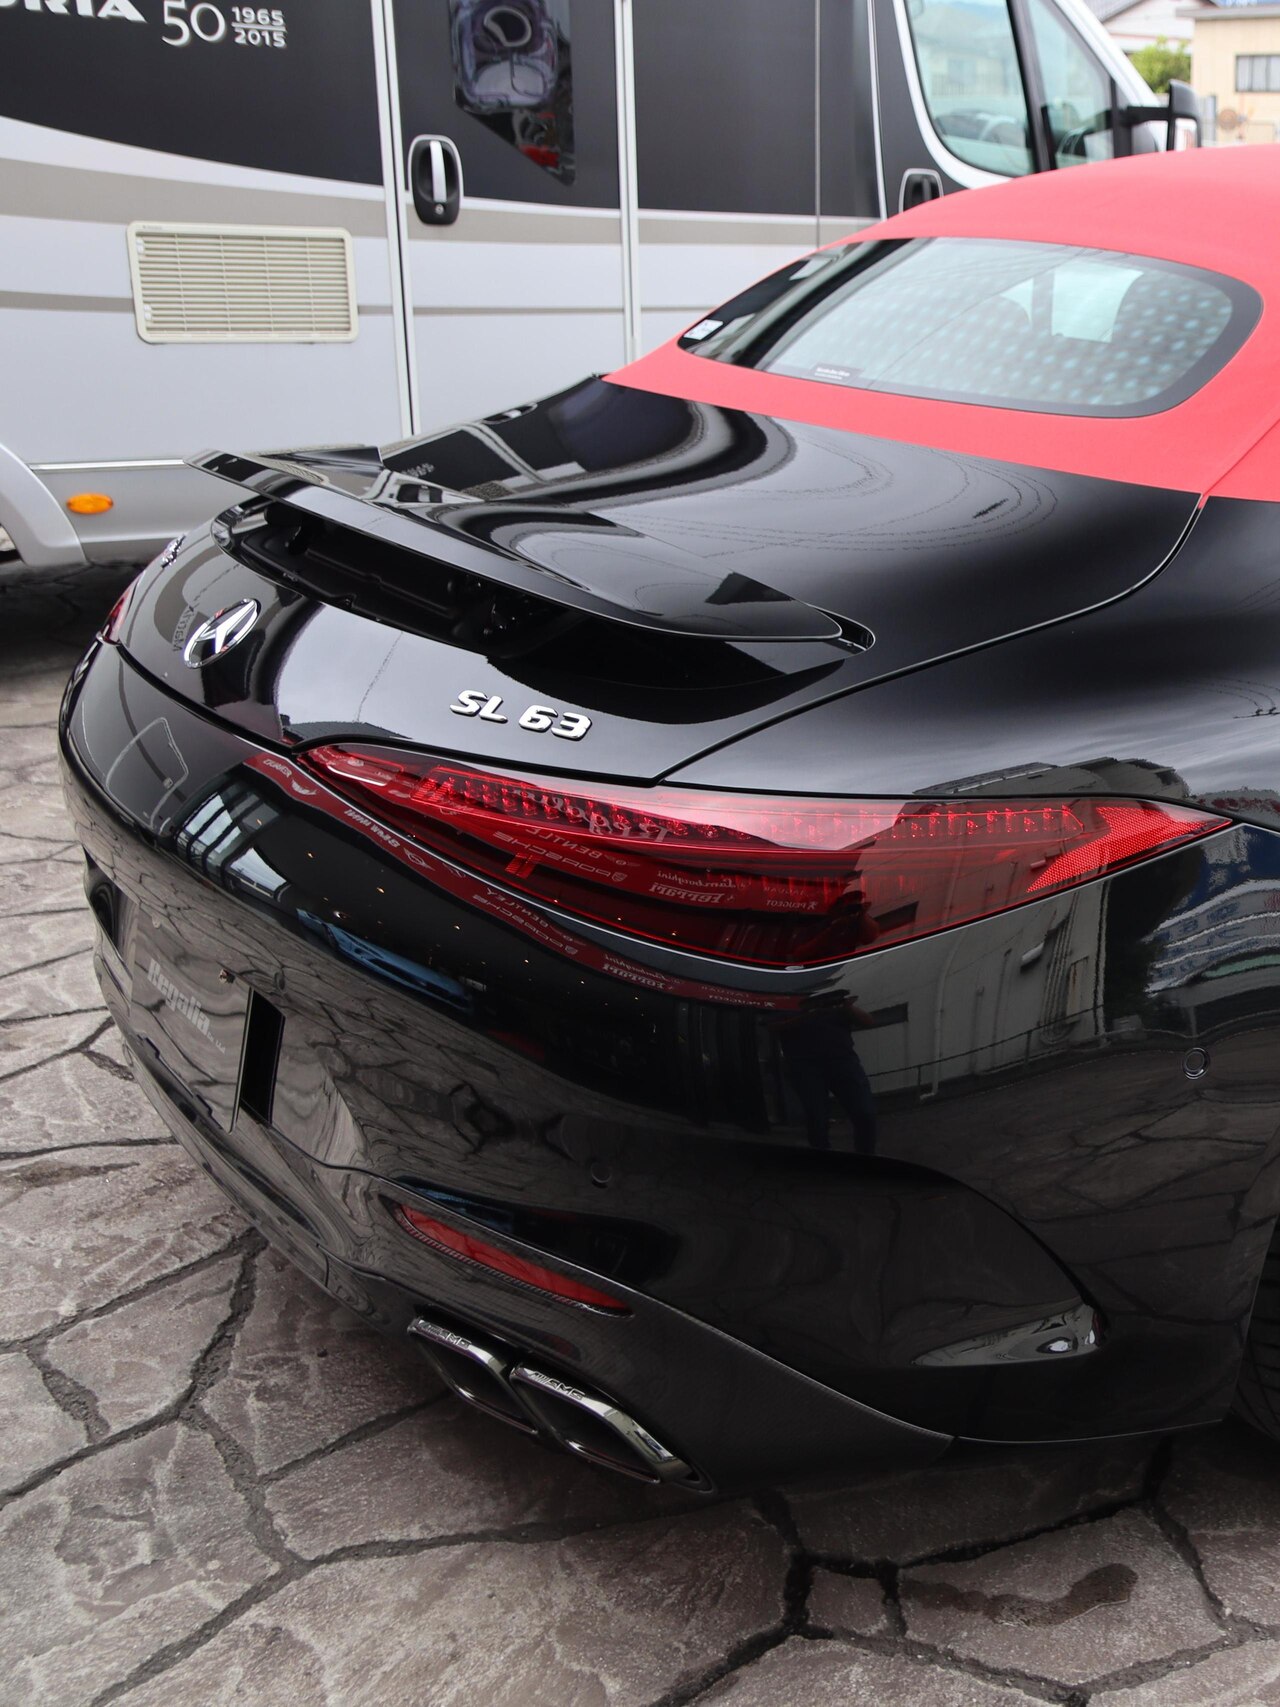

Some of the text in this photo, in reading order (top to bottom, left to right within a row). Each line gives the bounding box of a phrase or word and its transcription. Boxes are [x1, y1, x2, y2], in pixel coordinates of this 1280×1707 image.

[162, 0, 226, 47] 50
[231, 7, 285, 26] 1965
[234, 27, 286, 48] 2015
[449, 689, 593, 741] SL 63
